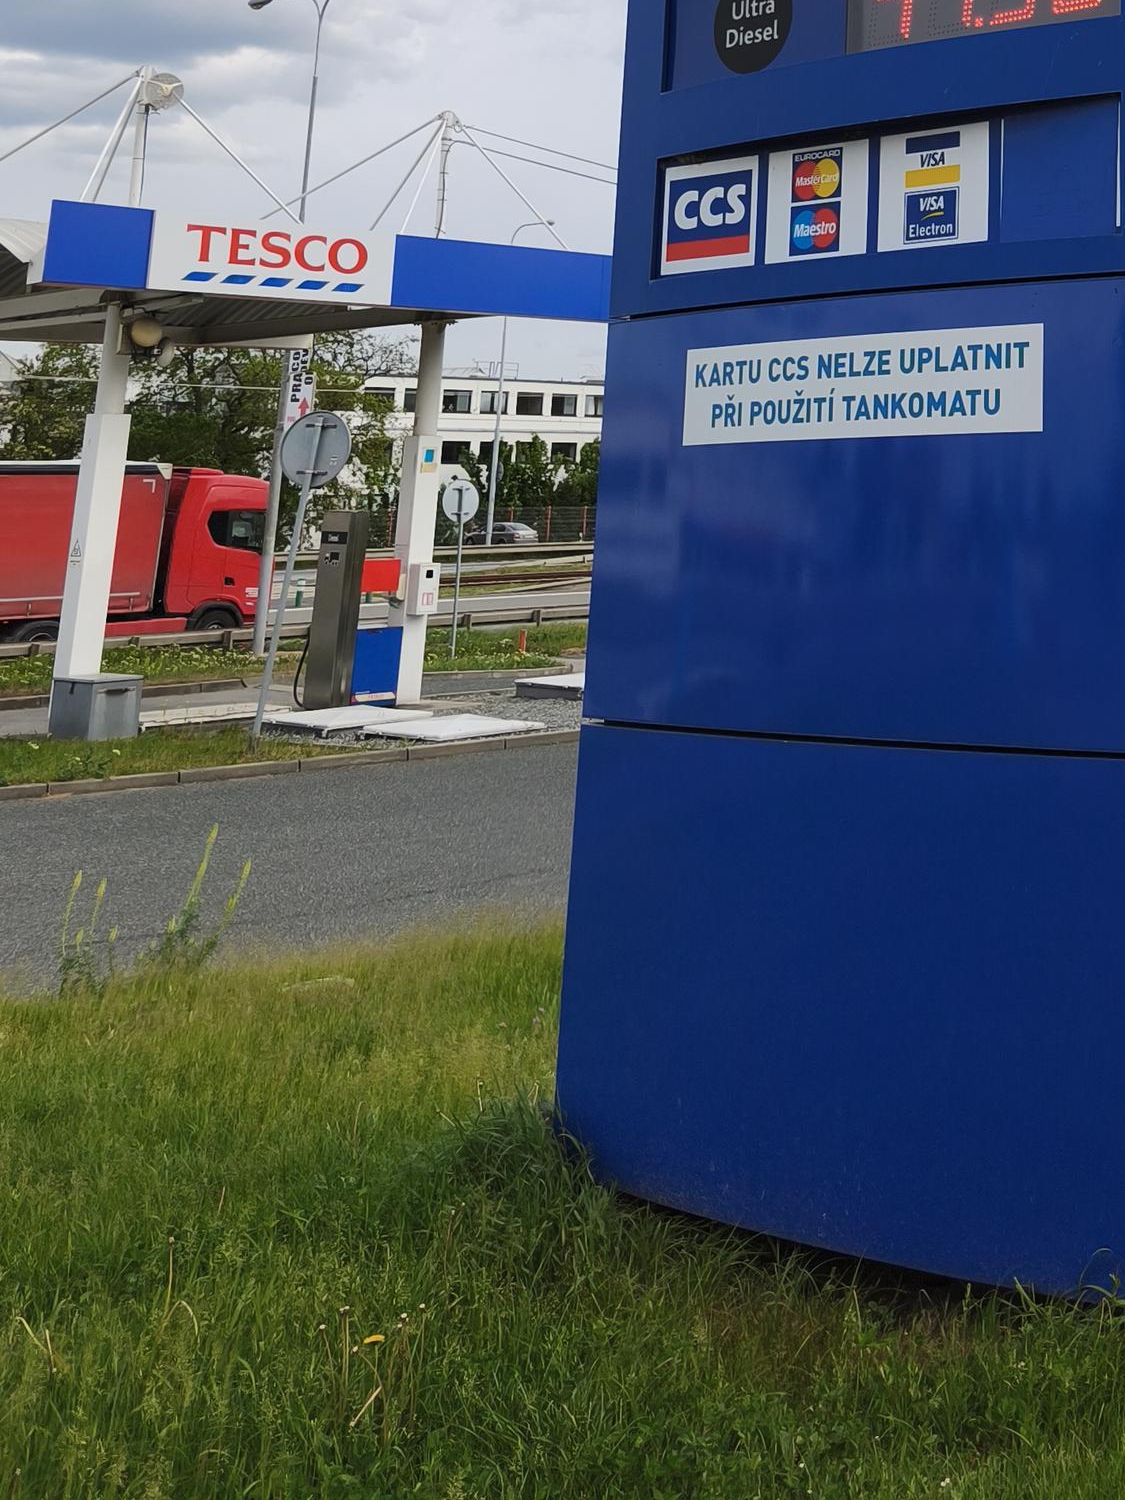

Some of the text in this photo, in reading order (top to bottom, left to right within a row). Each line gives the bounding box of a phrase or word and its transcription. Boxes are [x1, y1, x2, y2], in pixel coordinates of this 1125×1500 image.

[725, 19, 779, 49] Diesel
[794, 149, 841, 163] EUROCARD
[920, 151, 946, 168] VISA
[795, 172, 839, 188] MasterCard
[673, 182, 746, 230] CCS
[919, 195, 945, 212] VISA
[793, 220, 837, 239] Maestro
[908, 222, 953, 239] Electron
[187, 224, 369, 275] TESCO
[695, 341, 1030, 388] KARTU CCS NELZE UPLATNIT
[711, 388, 1001, 429] PŘI POUŽITÍ TANKOMATU
